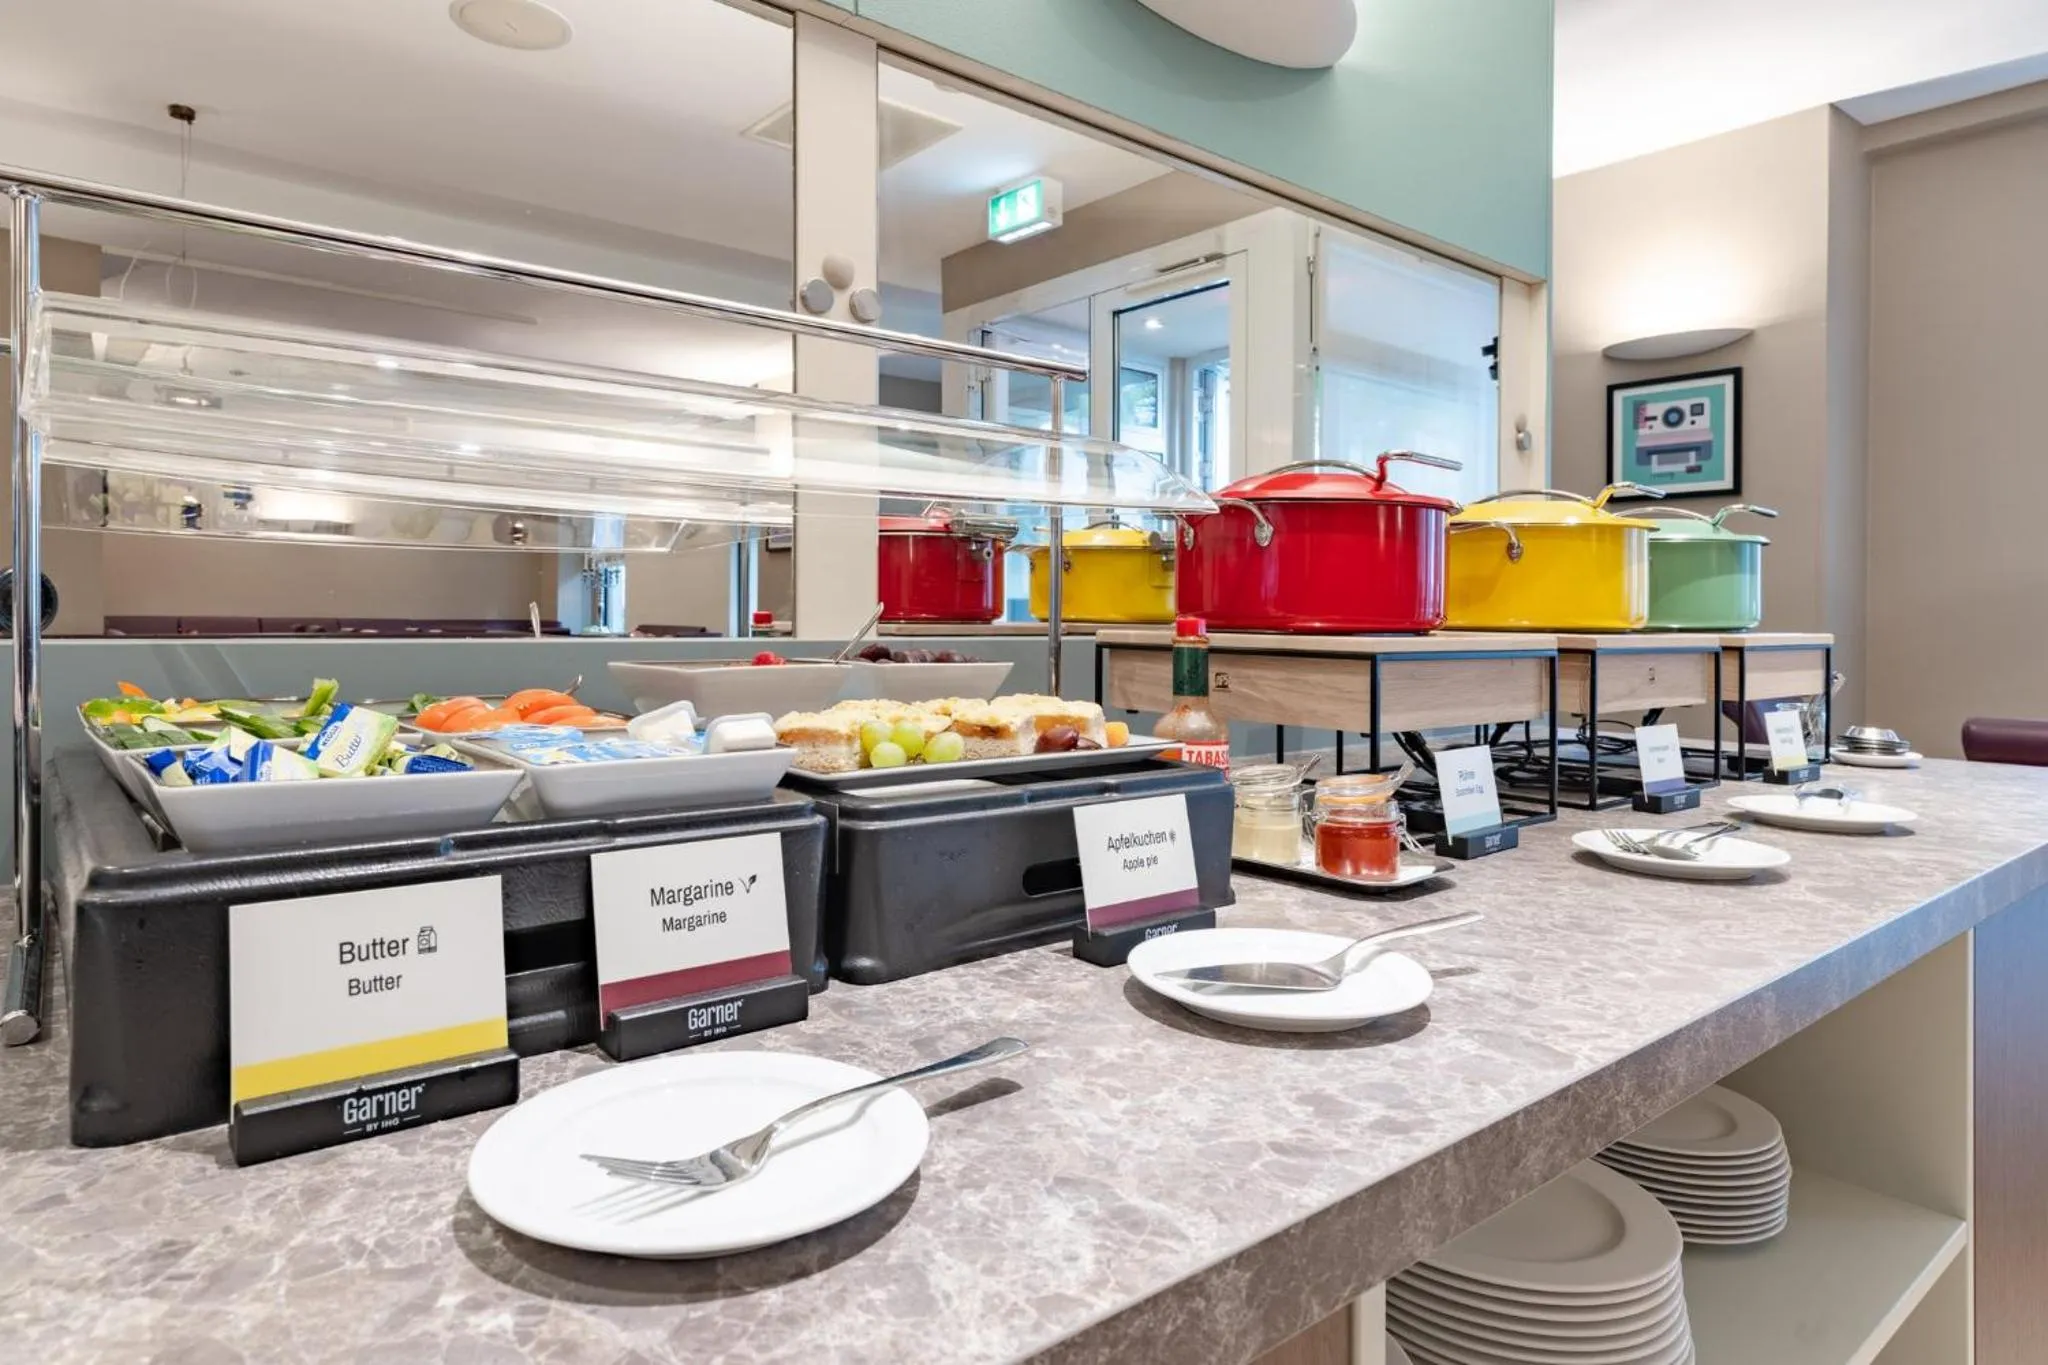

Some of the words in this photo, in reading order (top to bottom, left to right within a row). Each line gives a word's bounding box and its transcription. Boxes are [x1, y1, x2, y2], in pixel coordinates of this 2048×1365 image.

[1187, 750, 1229, 768] TABAS
[1107, 829, 1168, 853] Apfelkuchen
[1123, 857, 1145, 872] Apple
[1146, 854, 1159, 869] pie
[650, 879, 734, 907] Margarine
[662, 909, 727, 933] Margarine
[338, 936, 410, 965] Butter
[347, 974, 403, 997] Butter
[688, 1000, 743, 1030] Garner
[343, 1085, 424, 1125] Garner
[365, 1121, 379, 1133] BY
[381, 1117, 400, 1129] IHG
